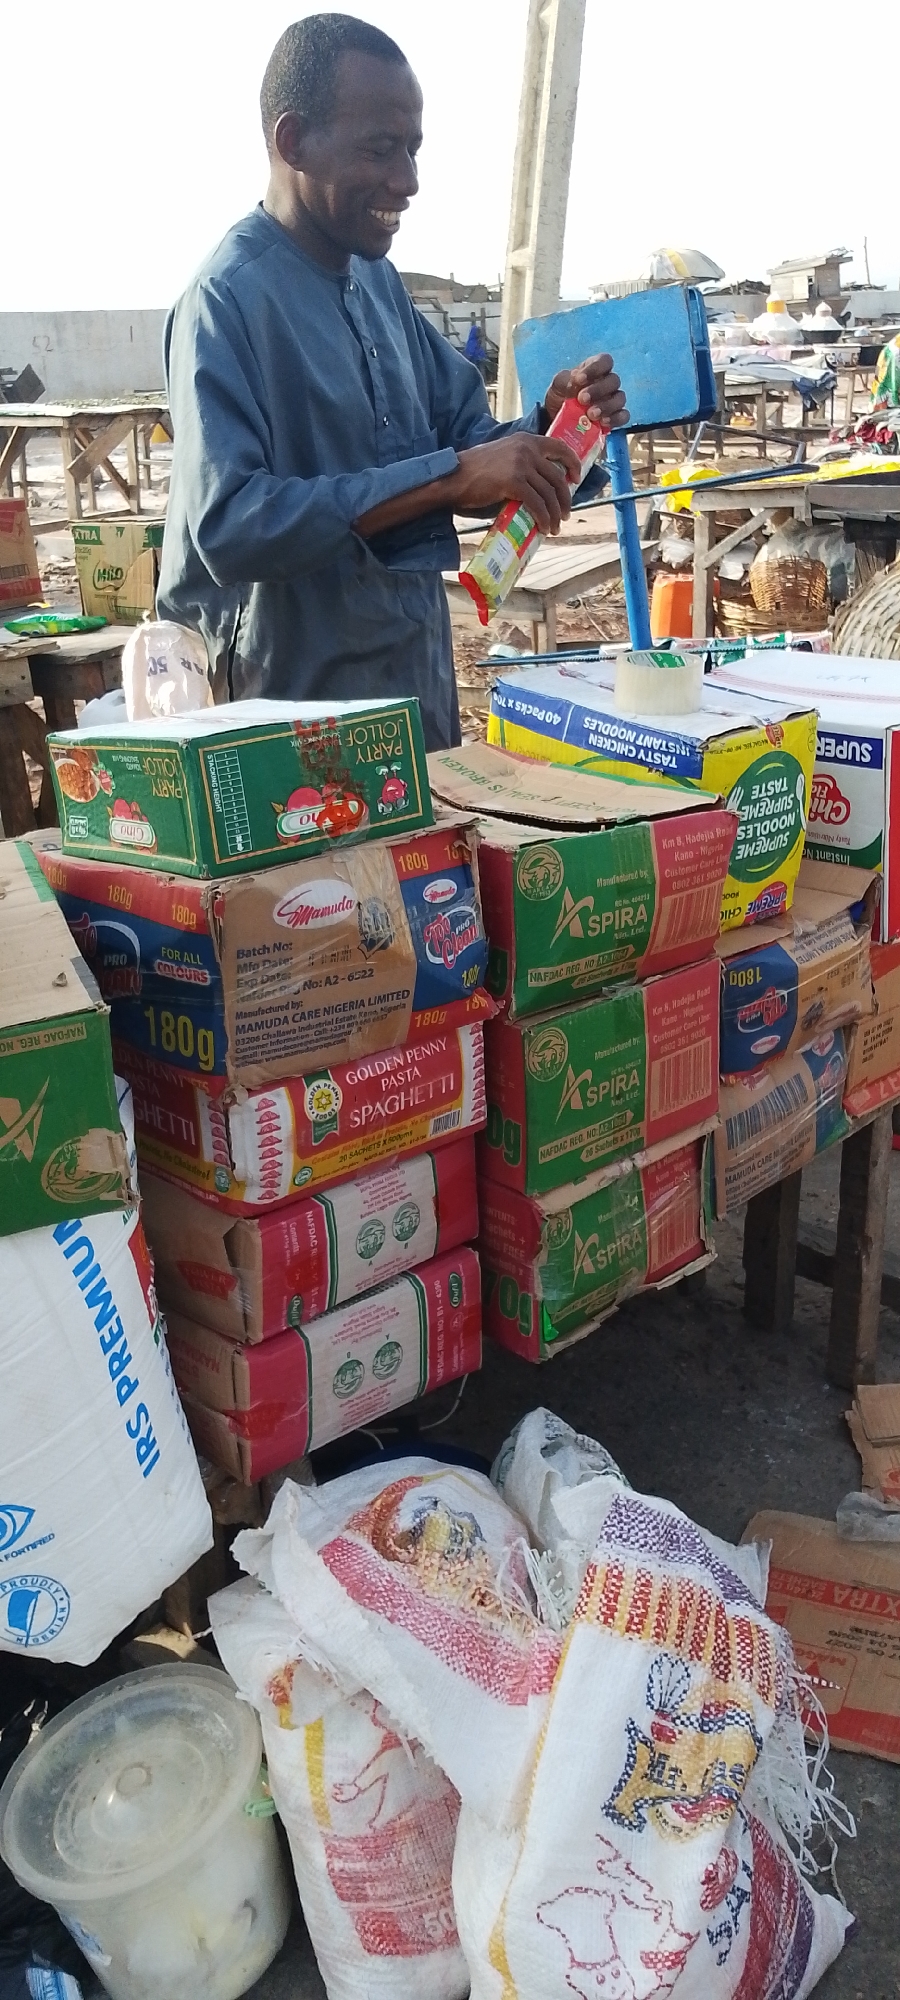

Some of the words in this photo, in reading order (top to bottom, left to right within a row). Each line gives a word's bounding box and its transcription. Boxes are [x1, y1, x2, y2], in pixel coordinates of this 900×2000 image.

[515, 701, 545, 722] Packs
[545, 714, 562, 726] 40
[345, 718, 404, 747] JOLLOF
[583, 717, 637, 741] NOODLES
[356, 739, 403, 765] PARTY
[588, 733, 637, 758] CHICKEN
[636, 733, 690, 757] INSTANT
[816, 736, 873, 763] SUPER
[142, 757, 179, 777] JOLLOF
[638, 750, 678, 769] TASTY
[206, 754, 219, 787] STACKING
[437, 756, 489, 787] BROKEN
[151, 778, 183, 798] PARTY
[489, 783, 507, 795] IS
[508, 788, 542, 803] SEAL
[751, 776, 789, 800] TASTE
[212, 787, 223, 813] HEIGHT
[741, 794, 795, 821] SUPREME
[121, 825, 144, 841] Gino
[736, 812, 796, 841] NOODLES
[662, 836, 676, 849] Km
[685, 832, 715, 845] Hadejia
[735, 831, 790, 861] SUPREME
[399, 852, 429, 873] 180g
[674, 851, 694, 862] Kano
[700, 844, 724, 858] Nigeria
[814, 850, 850, 867] Instant
[48, 866, 67, 890] 180g
[664, 864, 698, 878] Customer
[699, 859, 715, 870] Care
[596, 871, 639, 888] Manufactured
[108, 885, 133, 910] 180g
[172, 903, 197, 929] 180g
[277, 889, 354, 928] Mamuda
[455, 921, 470, 935] PRO
[161, 947, 181, 961] FOR
[184, 951, 203, 965] ALL
[236, 942, 272, 960] Batch
[273, 941, 293, 954] No:
[442, 924, 479, 969] Clean
[104, 954, 127, 967] PRO
[157, 961, 209, 984] COLOURS
[236, 976, 259, 990] Exp
[302, 978, 323, 992] No:
[324, 974, 339, 987] A2
[347, 968, 375, 983] 6522
[529, 967, 564, 983] NAFDAC
[566, 963, 583, 976] REG.
[730, 966, 762, 987] 180g
[235, 1001, 290, 1020] Manufactured
[290, 999, 304, 1012] by:
[235, 1015, 290, 1036] MAMUDA
[291, 1007, 321, 1024] CARE
[324, 999, 366, 1017] NIGERIA
[367, 989, 411, 1007] LIMITED
[415, 1010, 447, 1028] 180g
[653, 1005, 663, 1017] Km
[661, 1014, 677, 1026] Kano
[683, 1005, 704, 1019] Nigeria
[261, 1027, 297, 1043] Challawa
[298, 1018, 335, 1034] Industrial
[335, 1012, 358, 1025] Estate
[380, 1002, 407, 1015] Nigeria
[653, 1026, 682, 1044] Customer
[683, 1019, 698, 1031] Care
[18, 1035, 42, 1049] REG.
[44, 1025, 85, 1044] NAFDAC
[144, 1006, 215, 1071] 180g
[235, 1041, 269, 1054] Customer
[269, 1033, 310, 1047] Information
[594, 1039, 632, 1061] Manufactured
[346, 1054, 404, 1085] GOLDEN
[406, 1037, 447, 1065] PENNY
[381, 1065, 422, 1092] PASTA
[349, 1073, 455, 1129] SPAGHETTI
[348, 1141, 382, 1160] SACHETS
[539, 1141, 568, 1161] NAFDAC
[569, 1134, 585, 1147] REG.
[725, 1163, 757, 1187] MAMUDA
[757, 1154, 773, 1169] CARE
[305, 1210, 318, 1248] NAFDAC
[485, 1223, 516, 1241] achets
[503, 1243, 525, 1261] FREE
[291, 1299, 301, 1320] Dufil
[126, 1402, 161, 1479] IRS
[4, 1533, 56, 1562] FORTIFIED
[0, 1577, 62, 1594] PROUDLY
